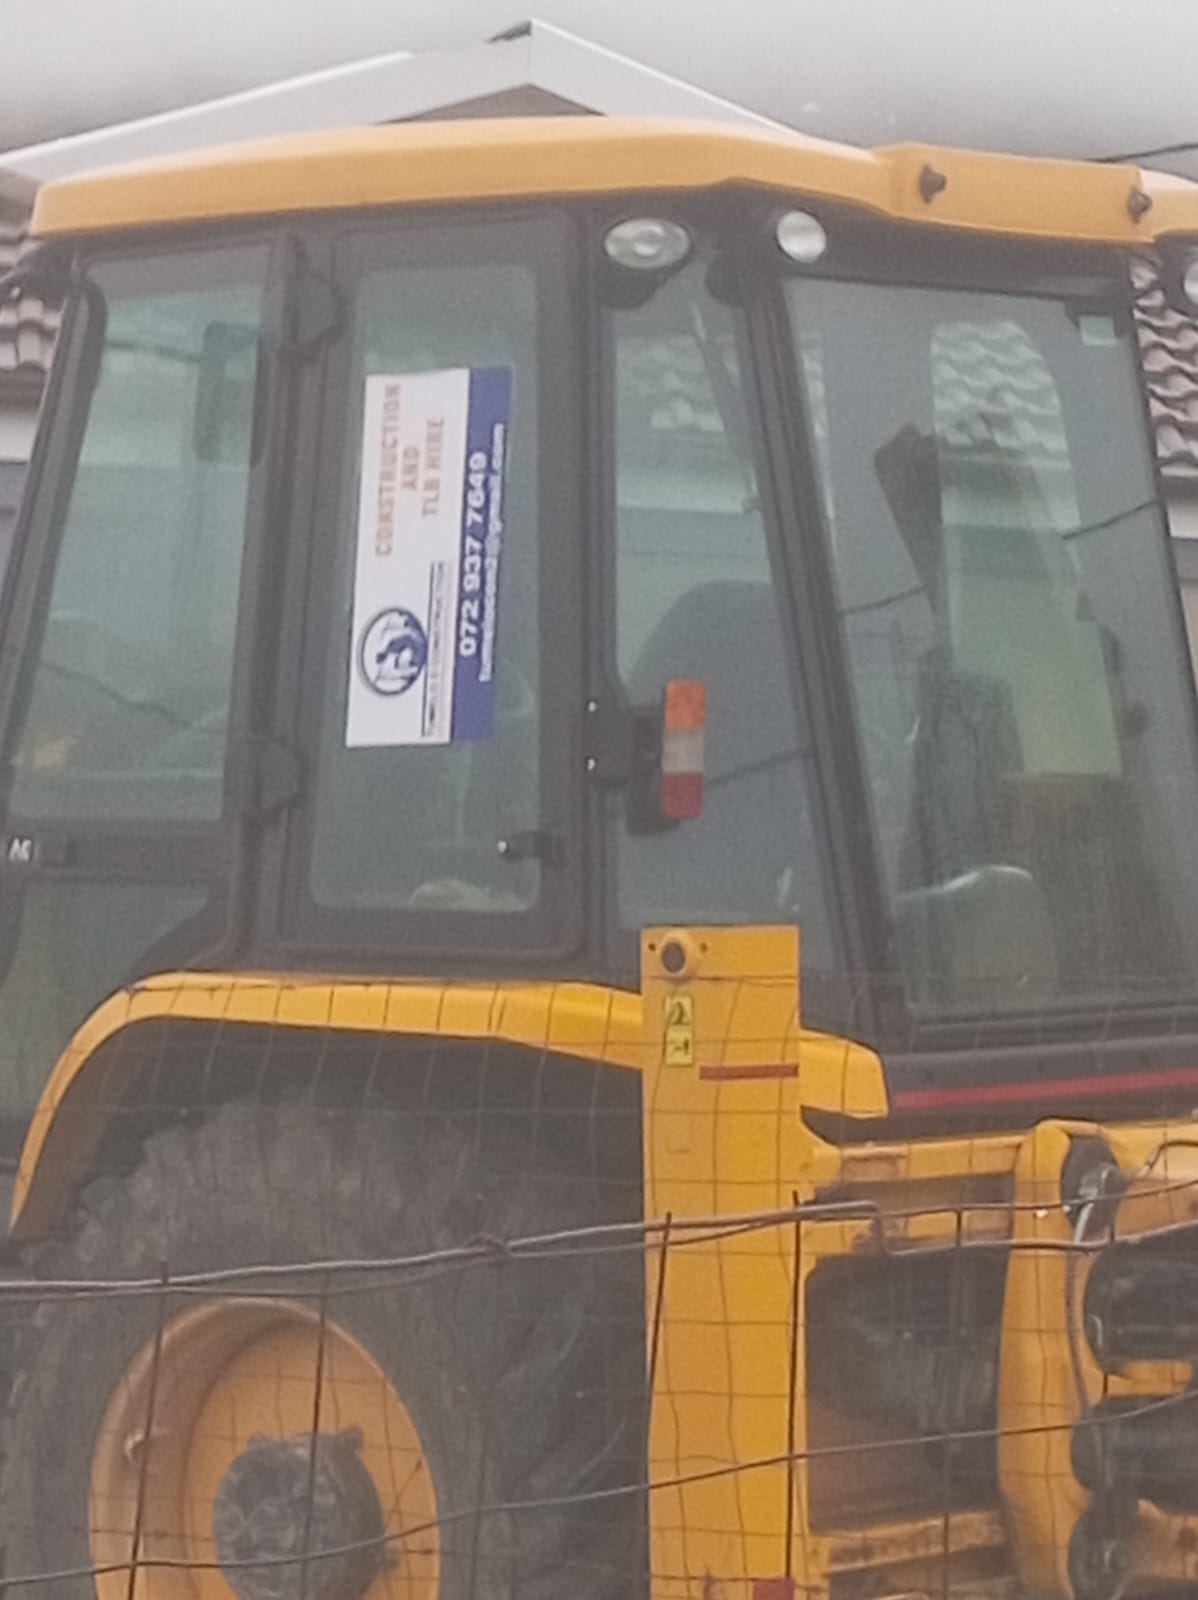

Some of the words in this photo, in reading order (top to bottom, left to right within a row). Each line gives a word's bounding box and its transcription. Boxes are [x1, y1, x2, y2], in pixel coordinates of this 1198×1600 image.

[375, 383, 400, 556] CONSTRUCTION
[401, 446, 419, 490] AND
[425, 416, 444, 469] HIRE
[422, 478, 440, 518] TLB
[466, 451, 487, 527] 7649
[463, 536, 484, 592] 937
[459, 600, 480, 656] 072
